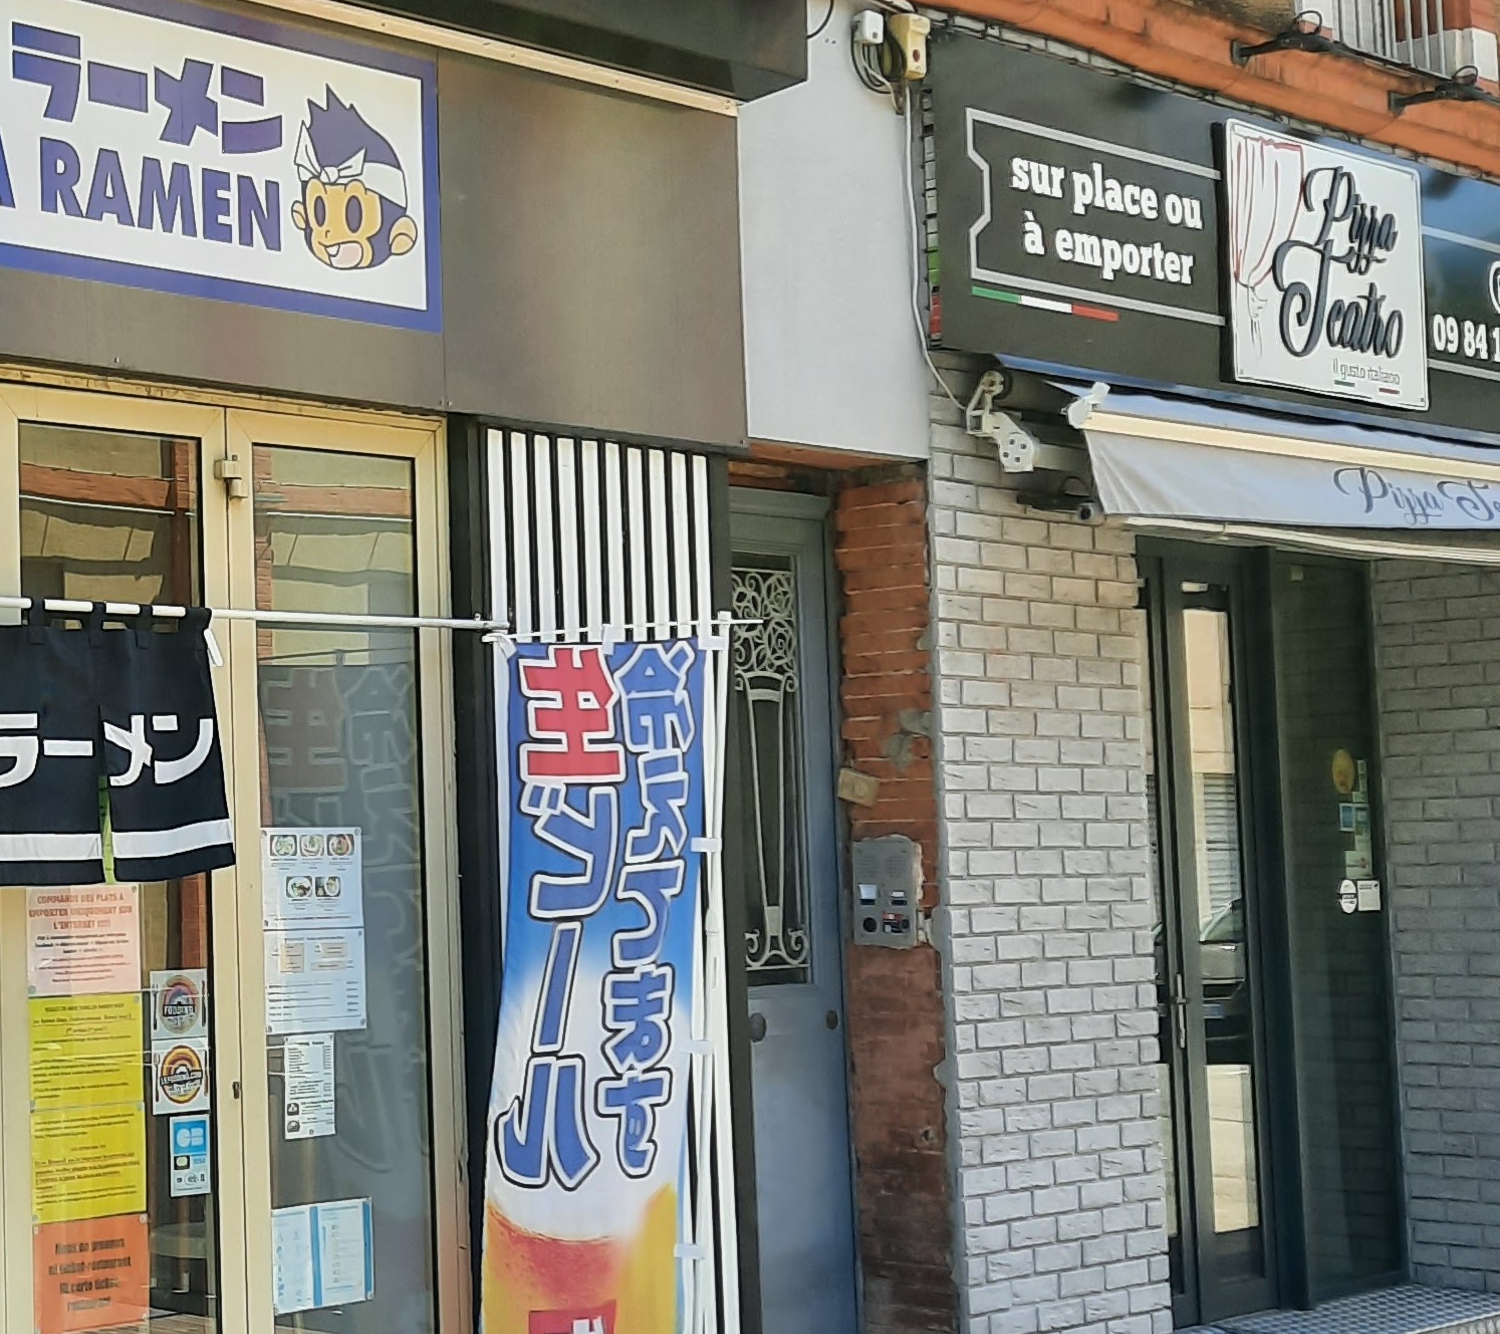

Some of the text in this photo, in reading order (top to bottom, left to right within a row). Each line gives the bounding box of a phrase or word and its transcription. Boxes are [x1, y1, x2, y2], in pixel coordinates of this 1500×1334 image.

[40, 137, 281, 253] RAMEN
[1010, 156, 1204, 230] sur place ou
[1304, 166, 1399, 275] Pizza
[1023, 210, 1194, 285] à emporter
[1272, 239, 1404, 358] Teatro
[1433, 314, 1459, 354] 09
[1464, 320, 1489, 360] 84
[1333, 466, 1444, 525] Pizza
